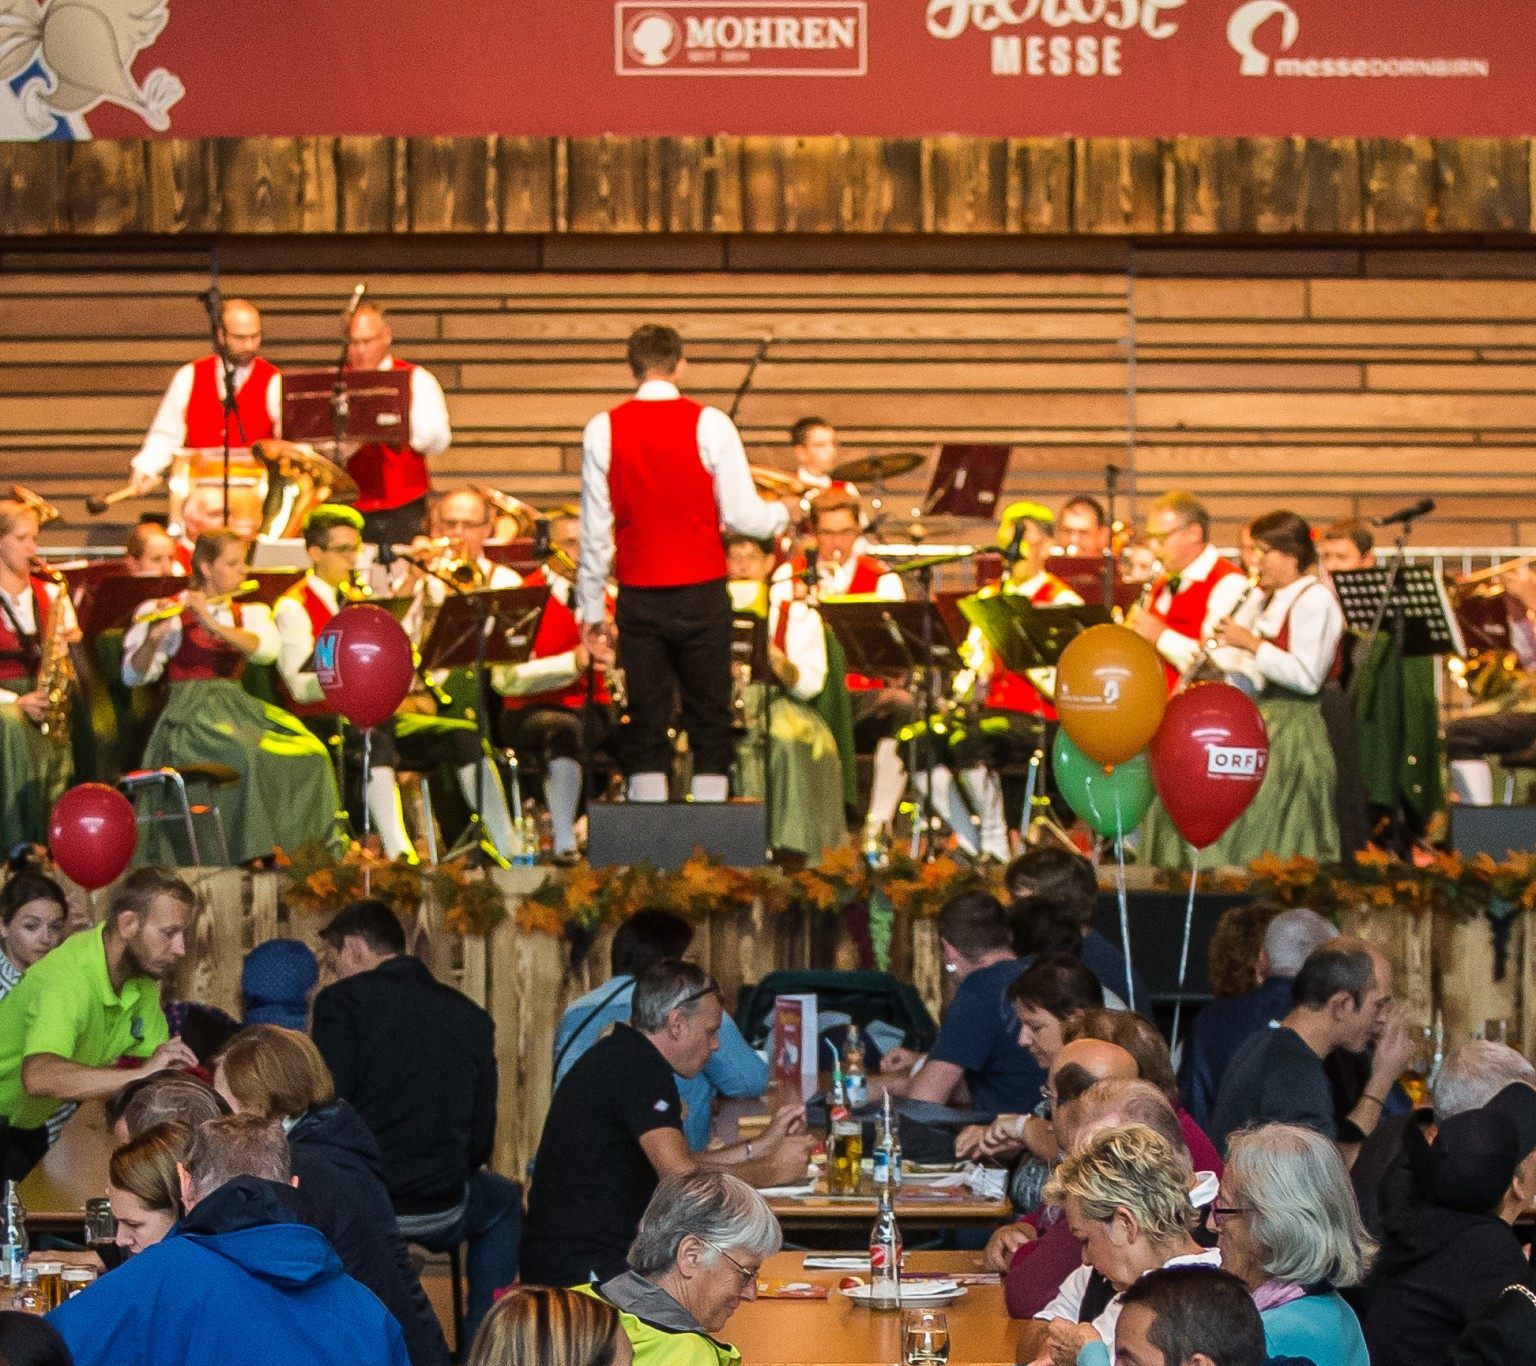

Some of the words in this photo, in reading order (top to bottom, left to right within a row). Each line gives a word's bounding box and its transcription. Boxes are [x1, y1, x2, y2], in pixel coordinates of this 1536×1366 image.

[685, 16, 856, 49] MOHREN
[991, 35, 1122, 76] MESSE
[1215, 753, 1254, 767] ORF
